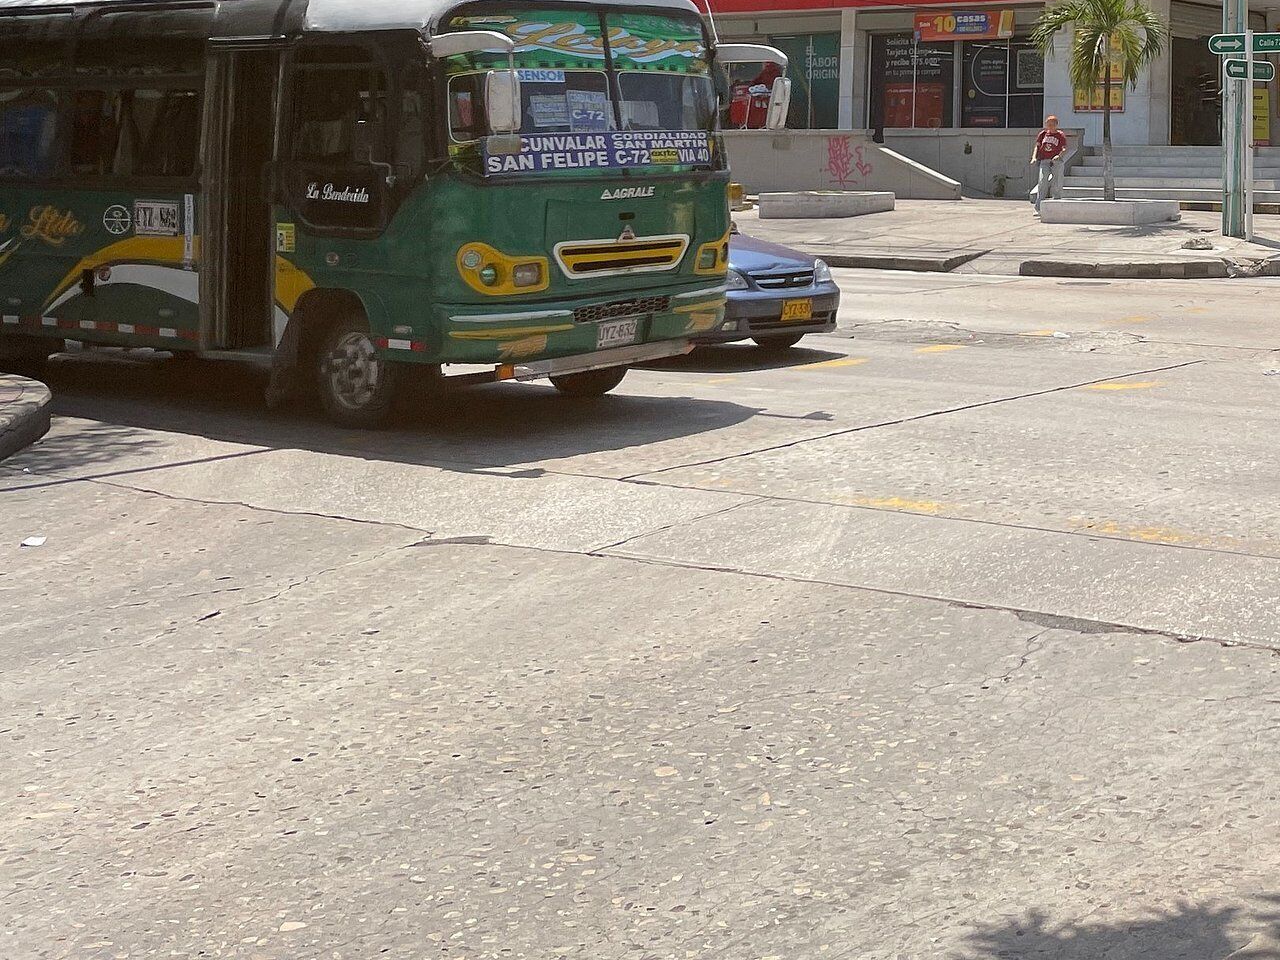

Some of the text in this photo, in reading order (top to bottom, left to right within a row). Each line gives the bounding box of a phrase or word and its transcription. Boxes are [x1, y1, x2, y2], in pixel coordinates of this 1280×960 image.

[933, 15, 956, 32] 10
[957, 15, 986, 23] casas
[806, 46, 817, 56] EL
[886, 48, 908, 58] Tarjeta
[806, 56, 838, 68] SABOR
[891, 58, 909, 66] recibe
[518, 70, 565, 83] SENSOR
[572, 109, 606, 121] C-72
[611, 131, 707, 140] CORDIALIDAD
[613, 139, 708, 149] SAN MARTIN
[487, 149, 651, 173] SAN FELIPE C-72
[679, 149, 696, 163] VIA
[697, 148, 709, 162] 40
[306, 182, 320, 199] La
[613, 186, 656, 199] AGRALE
